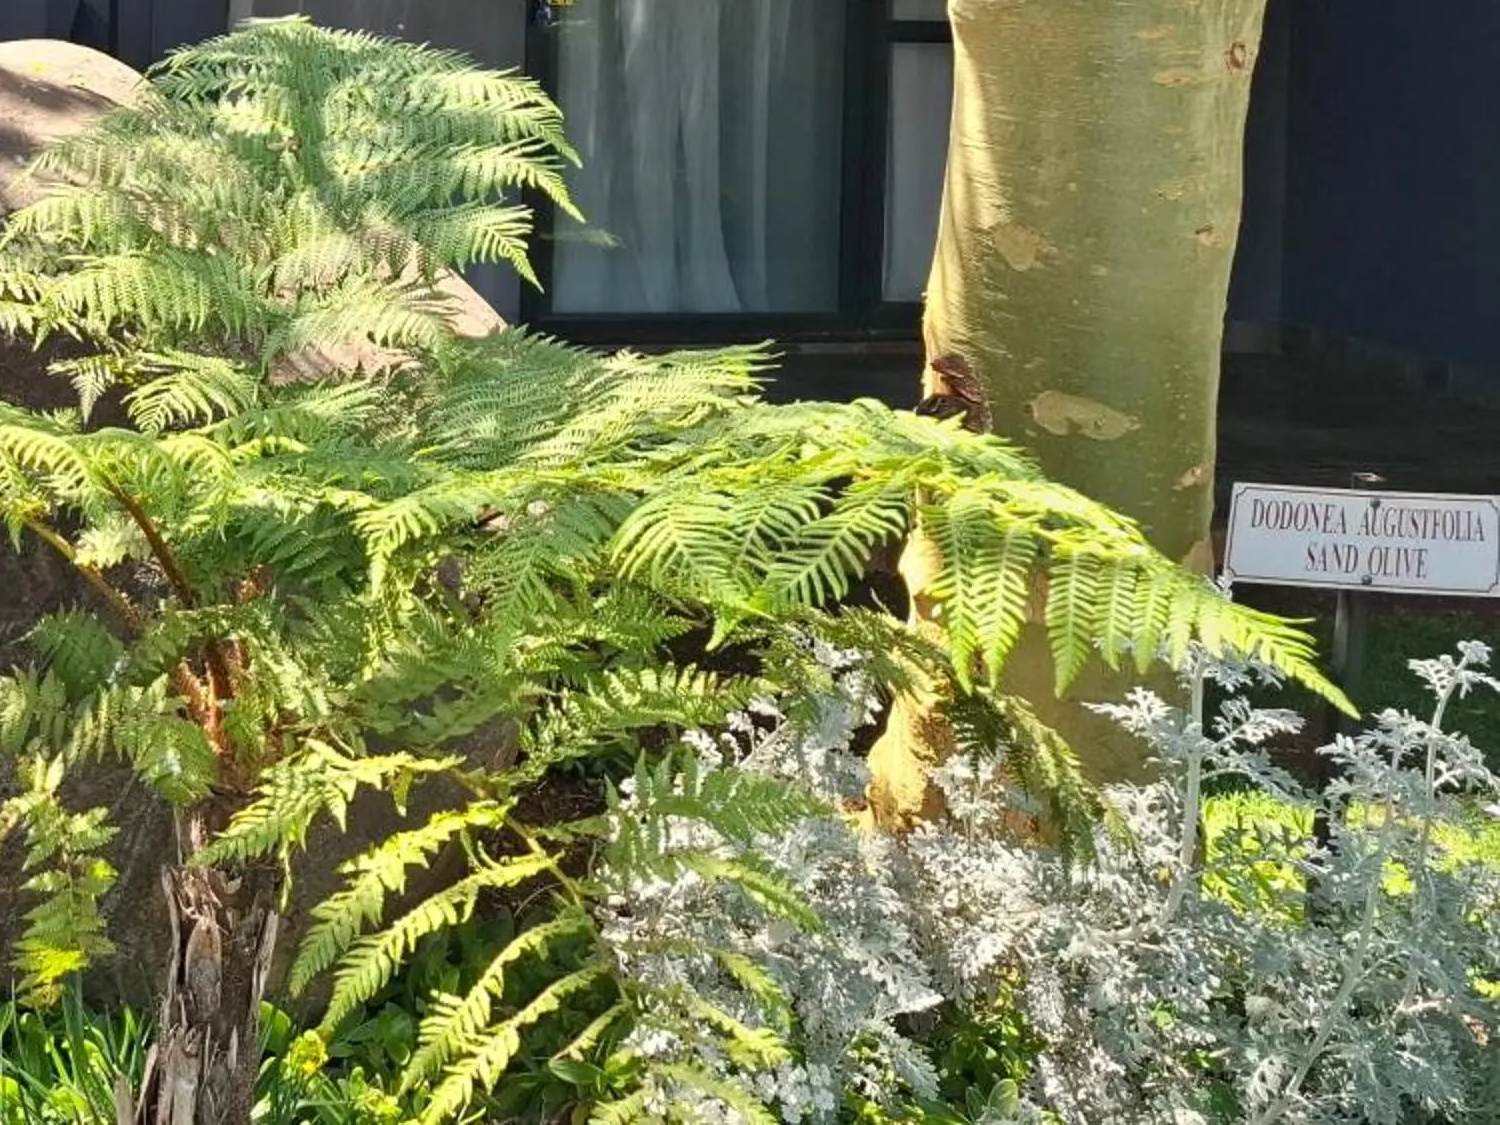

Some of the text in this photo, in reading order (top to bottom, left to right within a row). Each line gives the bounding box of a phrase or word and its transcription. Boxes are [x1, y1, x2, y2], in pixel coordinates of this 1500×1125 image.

[1251, 498, 1347, 535] DODONEA
[1305, 542, 1429, 580] SAND OLIVE
